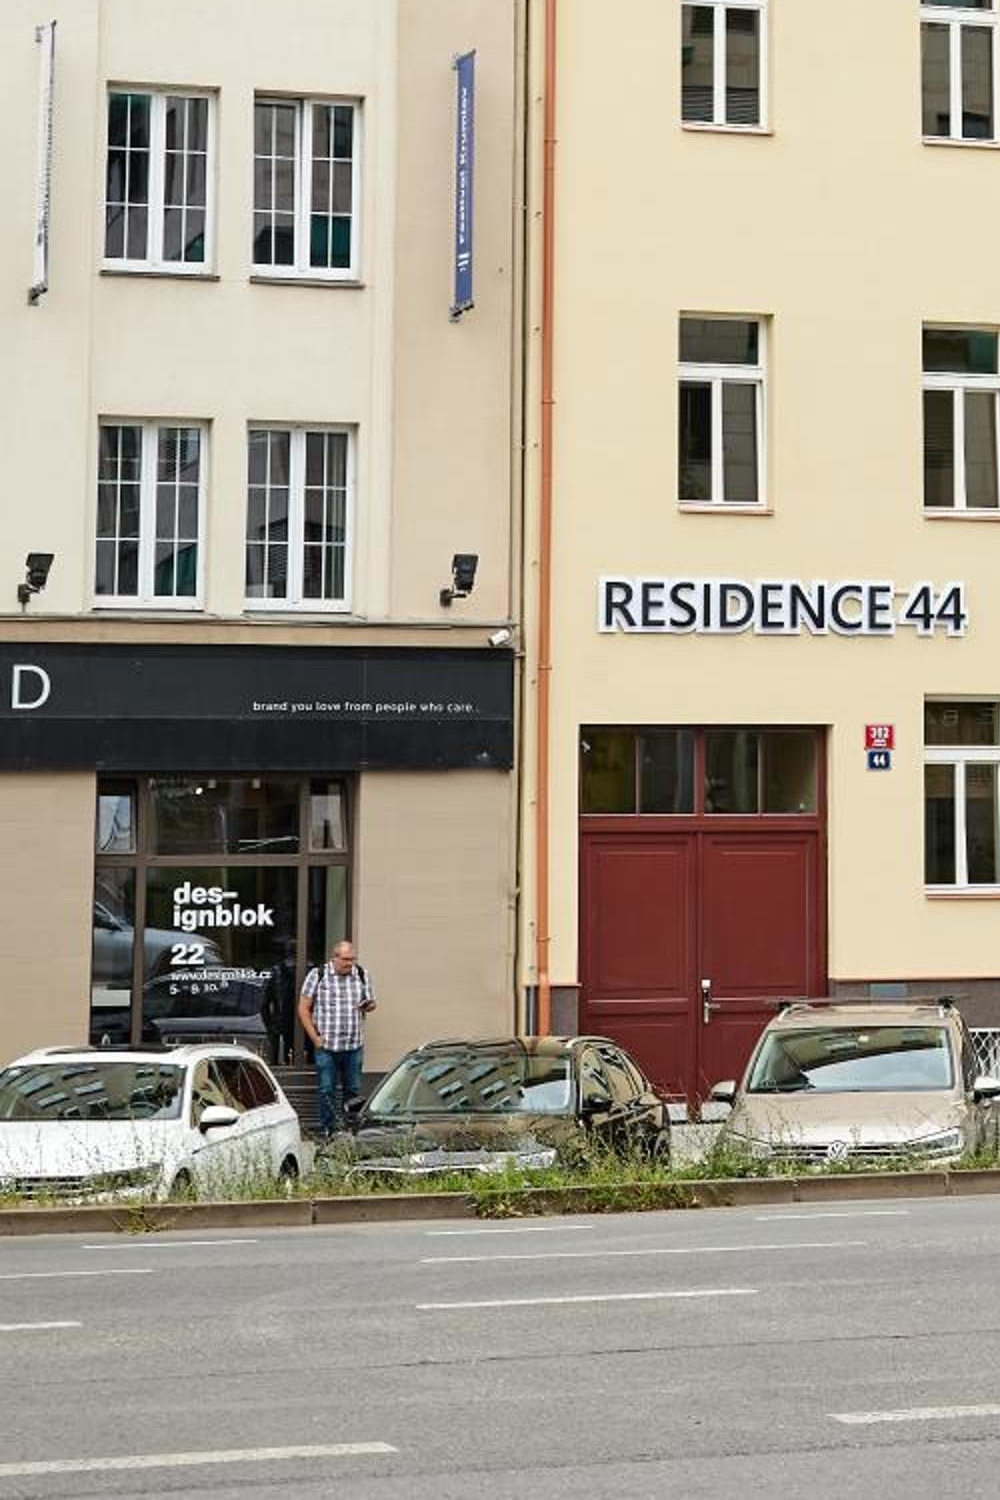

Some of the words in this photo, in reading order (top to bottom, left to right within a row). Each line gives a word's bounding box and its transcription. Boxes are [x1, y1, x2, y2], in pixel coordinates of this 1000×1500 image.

[604, 581, 892, 630] RESIDENCE
[904, 585, 966, 631] 44
[12, 664, 51, 709] D
[252, 701, 288, 712] brand
[291, 703, 313, 713] you
[315, 701, 341, 711] love
[344, 701, 373, 711] from
[375, 702, 417, 713] people
[420, 702, 443, 712] who
[873, 753, 886, 767] 44
[173, 903, 275, 932] ignblok
[169, 943, 206, 965] 22
